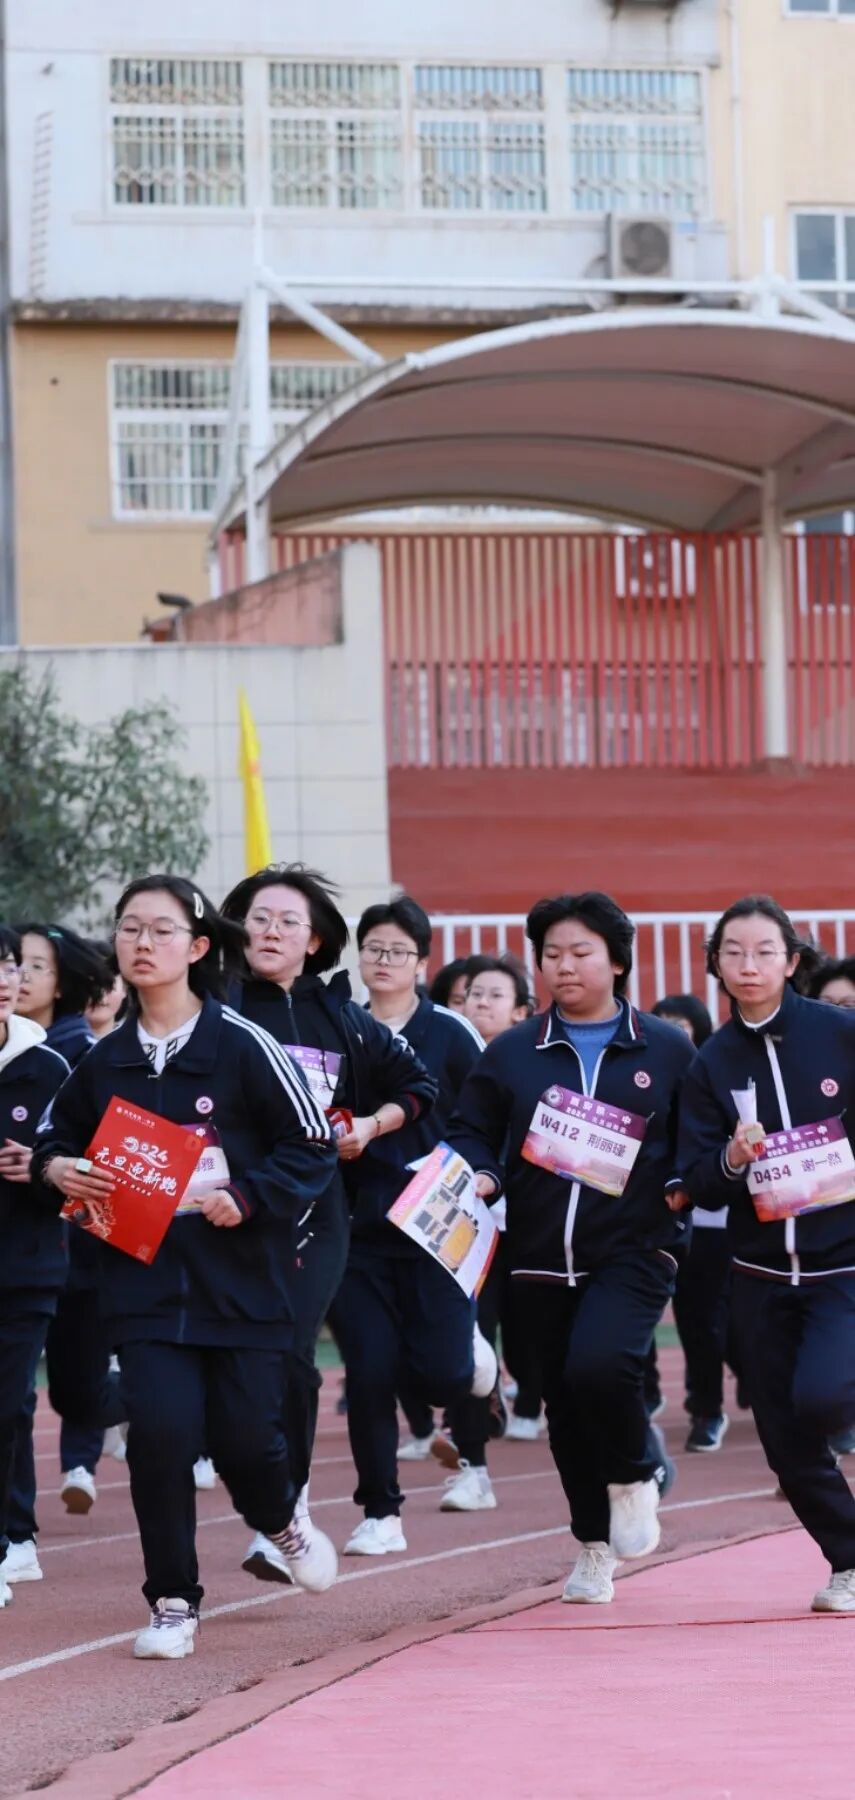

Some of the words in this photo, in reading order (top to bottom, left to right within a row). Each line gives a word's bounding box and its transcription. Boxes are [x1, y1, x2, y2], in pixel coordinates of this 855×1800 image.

[540, 1113, 580, 1141] W412
[95, 1146, 177, 1197] 元旦迎新跑
[753, 1164, 792, 1184] D434
